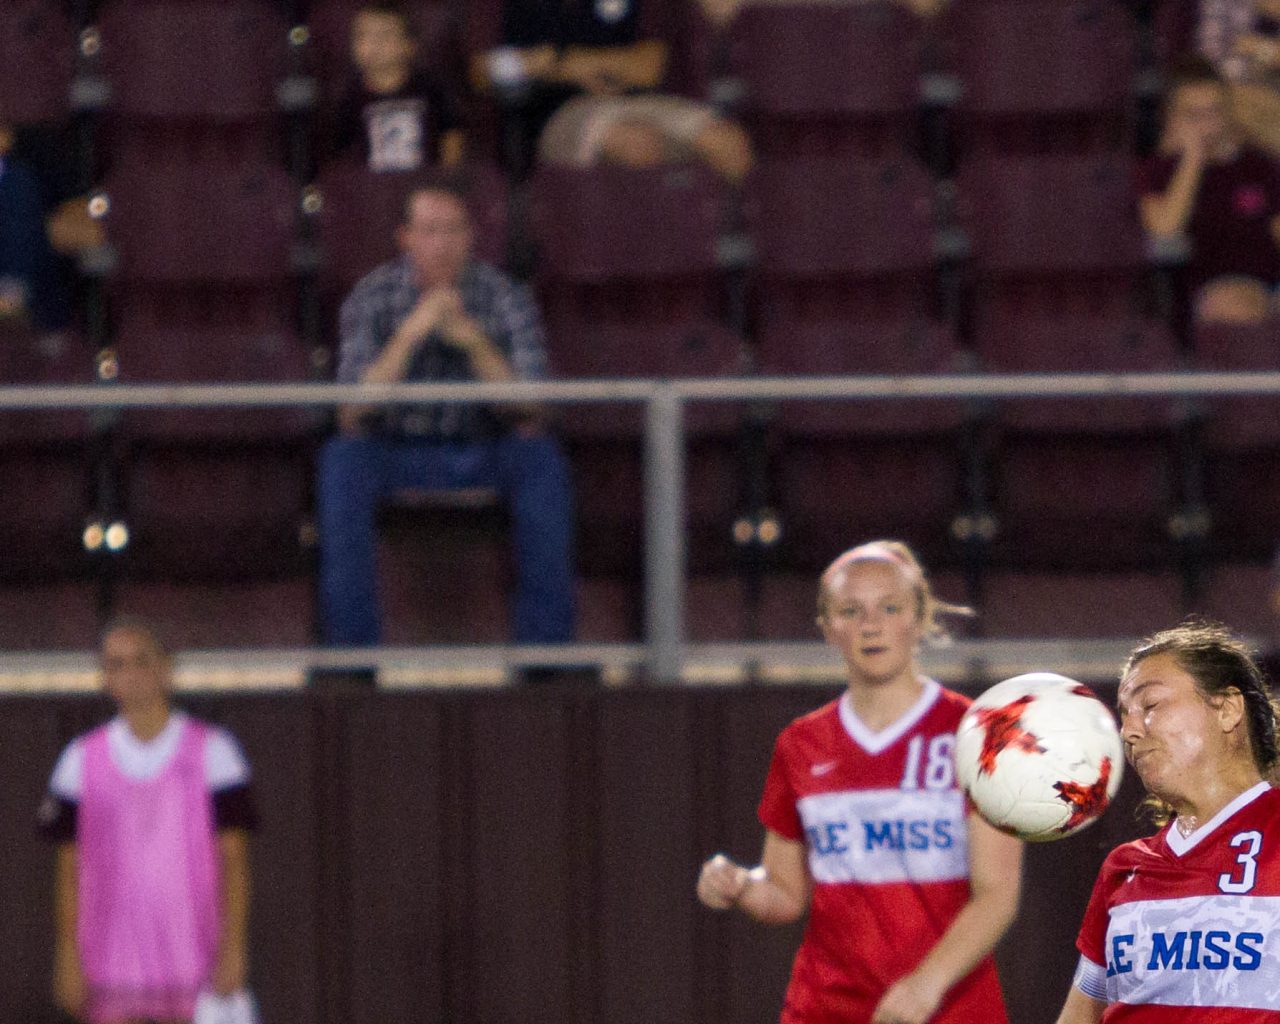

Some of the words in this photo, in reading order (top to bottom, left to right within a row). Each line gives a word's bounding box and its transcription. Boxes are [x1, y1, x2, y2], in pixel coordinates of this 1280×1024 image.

[899, 733, 957, 792] 18
[863, 819, 954, 853] MISS
[1217, 828, 1264, 896] 3
[1147, 931, 1264, 971] MISS
